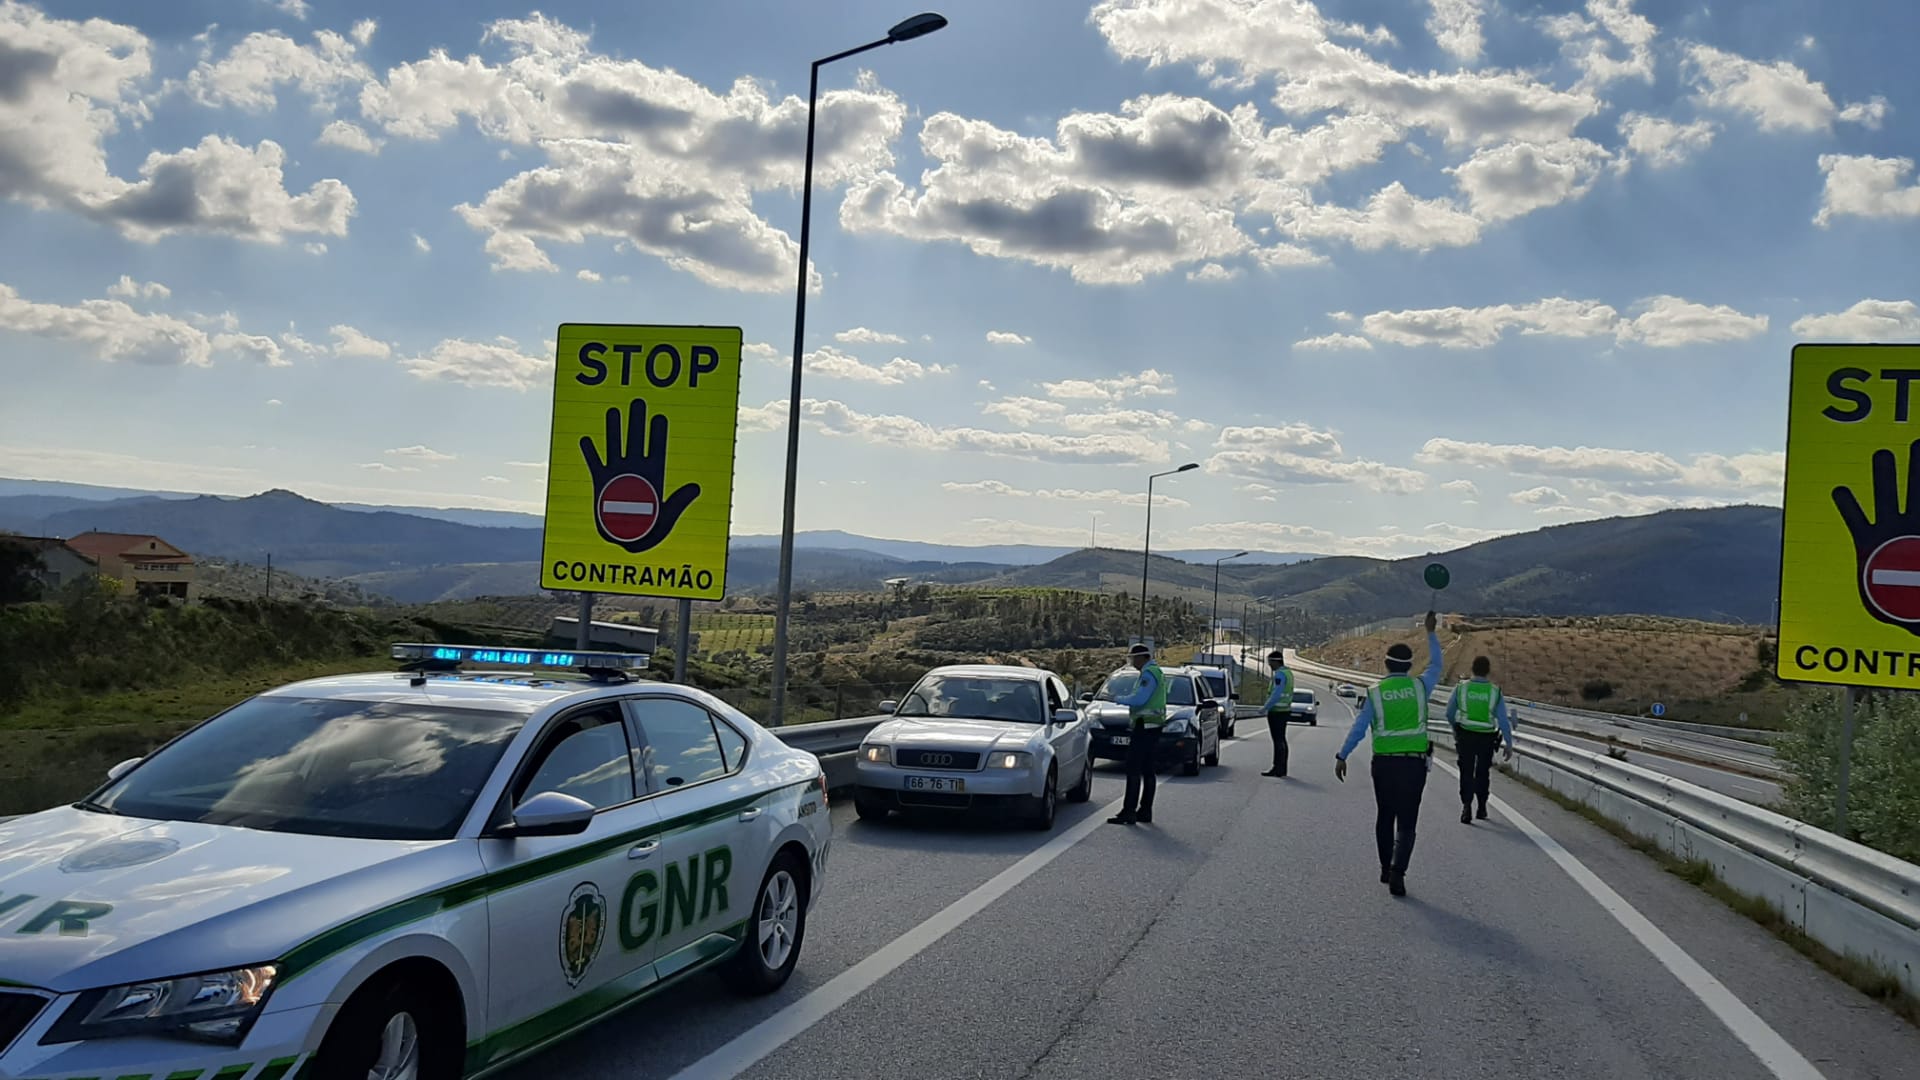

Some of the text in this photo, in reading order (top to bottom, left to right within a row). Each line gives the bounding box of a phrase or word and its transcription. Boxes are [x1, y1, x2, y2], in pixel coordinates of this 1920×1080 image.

[575, 342, 719, 388] STOP
[552, 560, 713, 590] CONTRAMÃO
[1382, 687, 1415, 701] GNR
[619, 845, 733, 951] GNR
